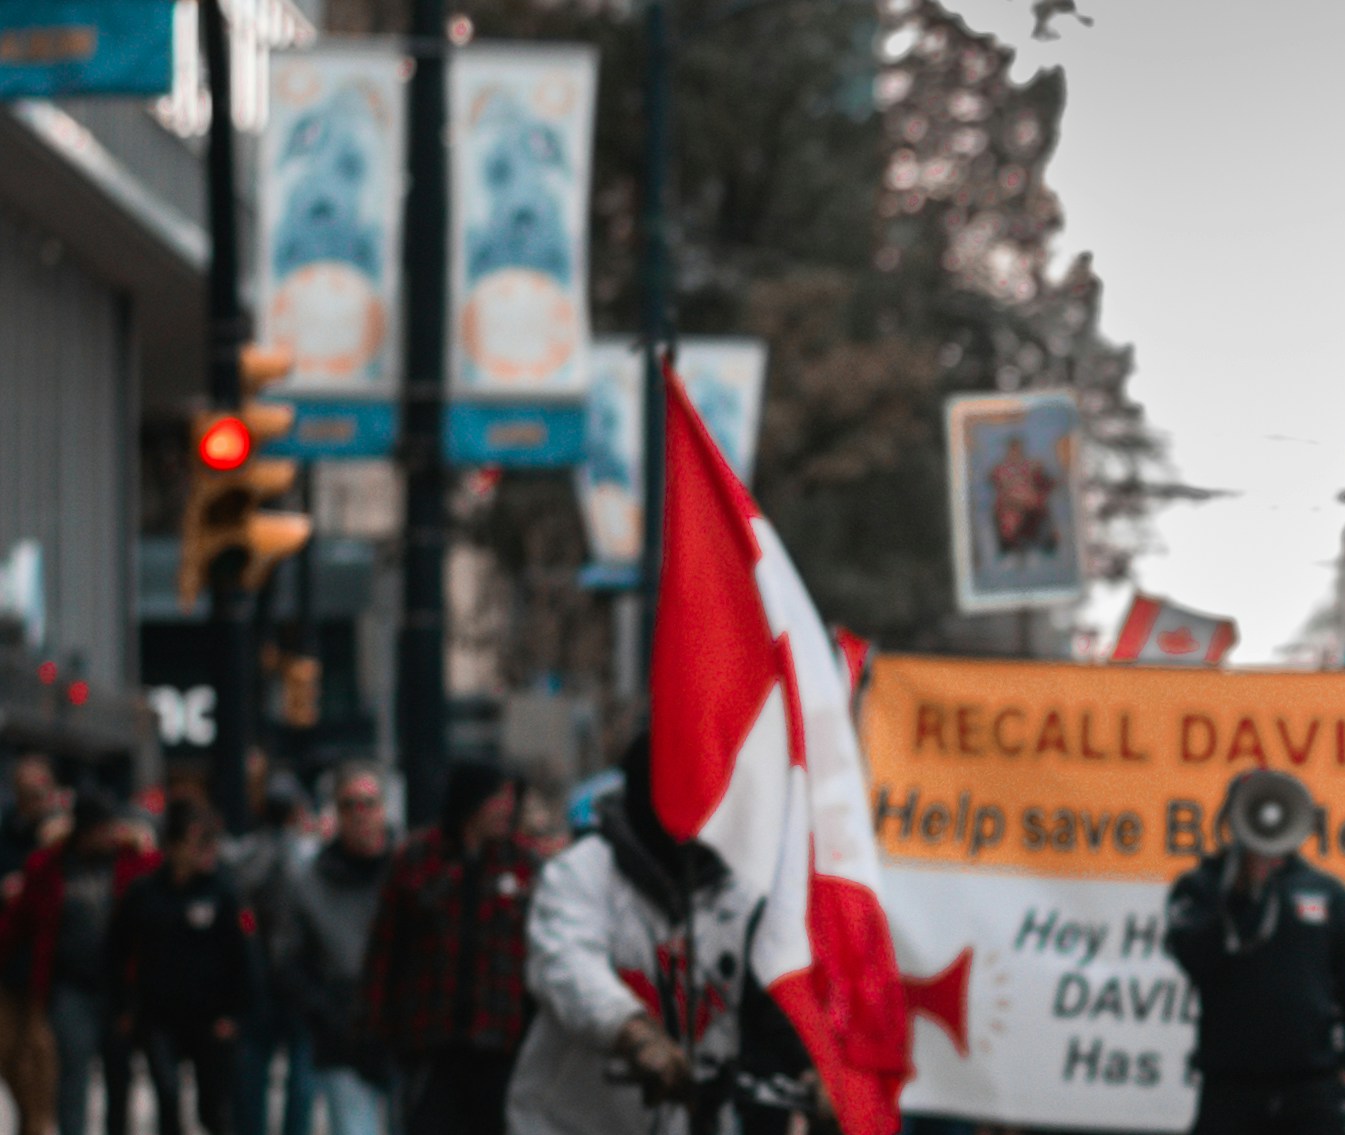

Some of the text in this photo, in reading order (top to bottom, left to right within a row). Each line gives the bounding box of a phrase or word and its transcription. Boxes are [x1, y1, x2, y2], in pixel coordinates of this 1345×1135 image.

[914, 703, 1148, 763] RECALL
[873, 787, 1005, 857] Help
[1022, 807, 1143, 852] save
[1013, 907, 1108, 966] Hey
[1120, 912, 1165, 959] H
[1063, 1036, 1162, 1087] Has
